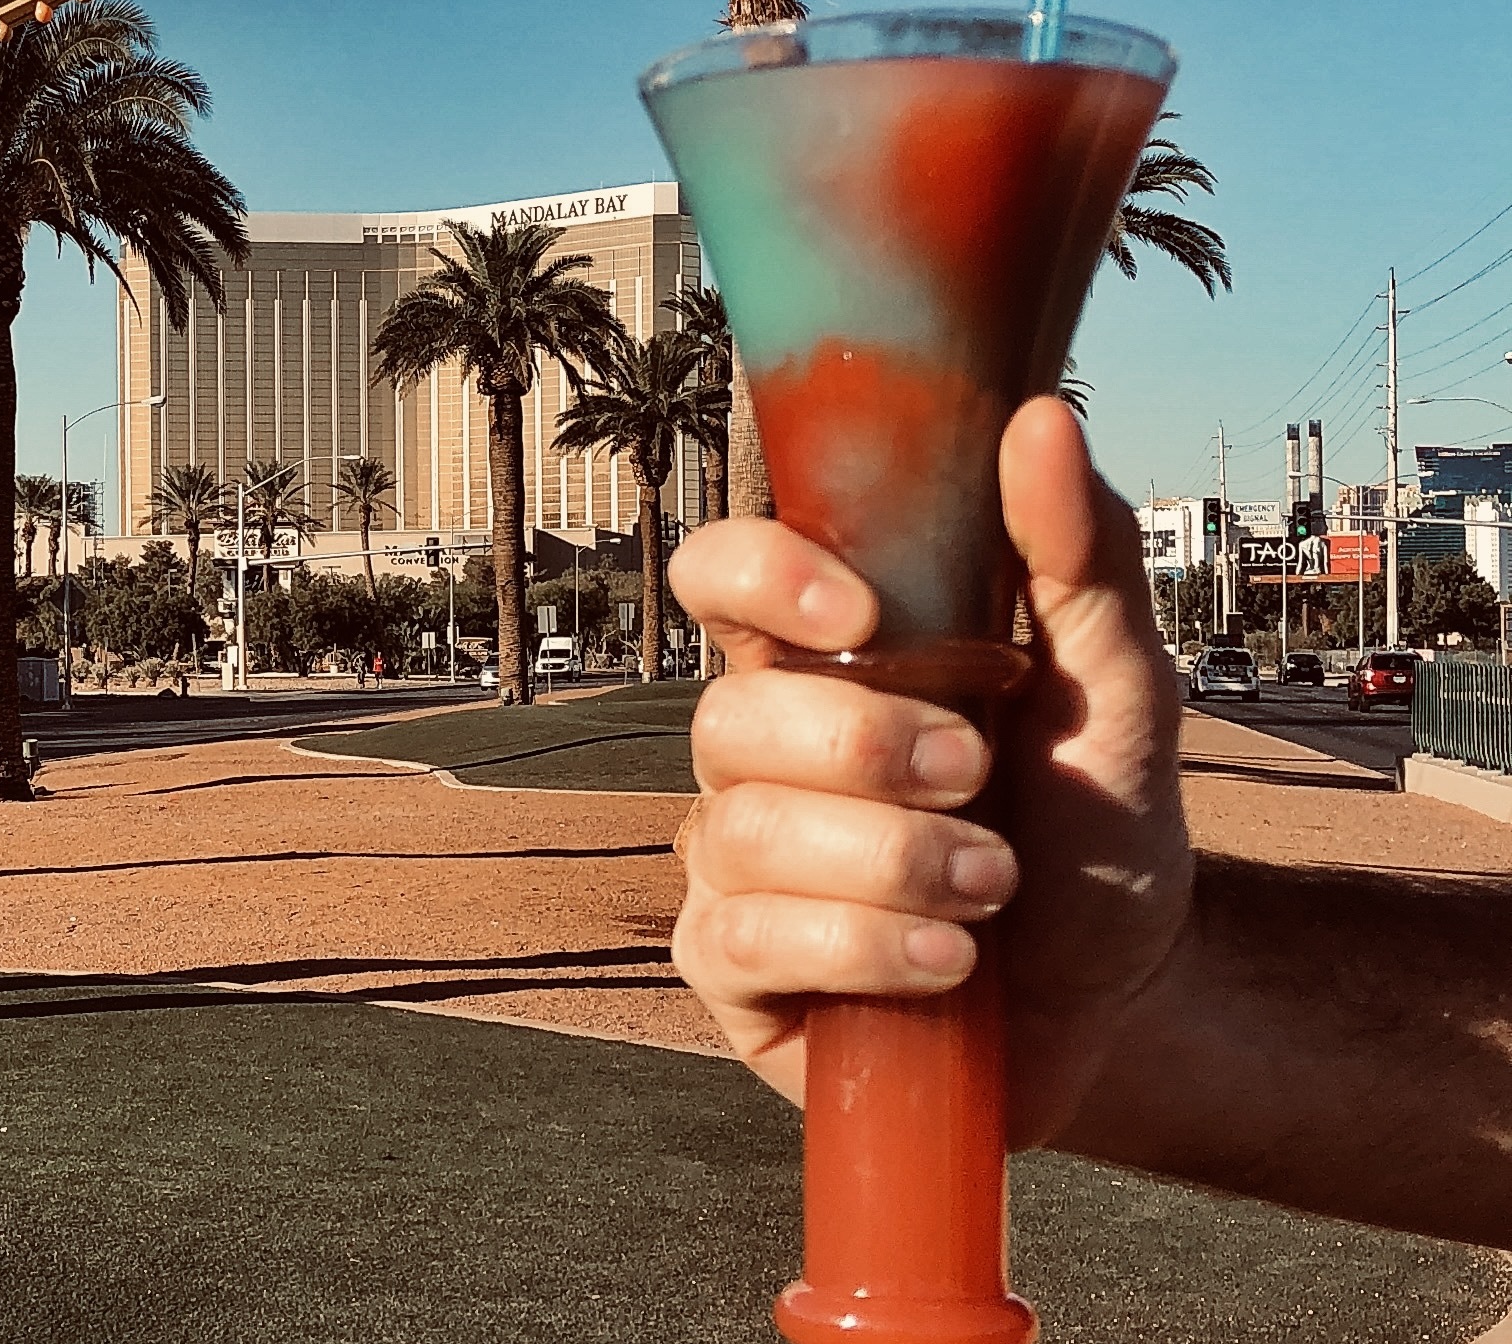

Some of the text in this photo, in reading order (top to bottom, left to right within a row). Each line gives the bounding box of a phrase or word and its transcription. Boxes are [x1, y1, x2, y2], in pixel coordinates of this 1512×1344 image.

[490, 194, 629, 227] MANDALAY BAY
[1235, 504, 1276, 513] EMERGENCY
[1241, 541, 1296, 562] TAO
[390, 556, 460, 566] CONVEION
